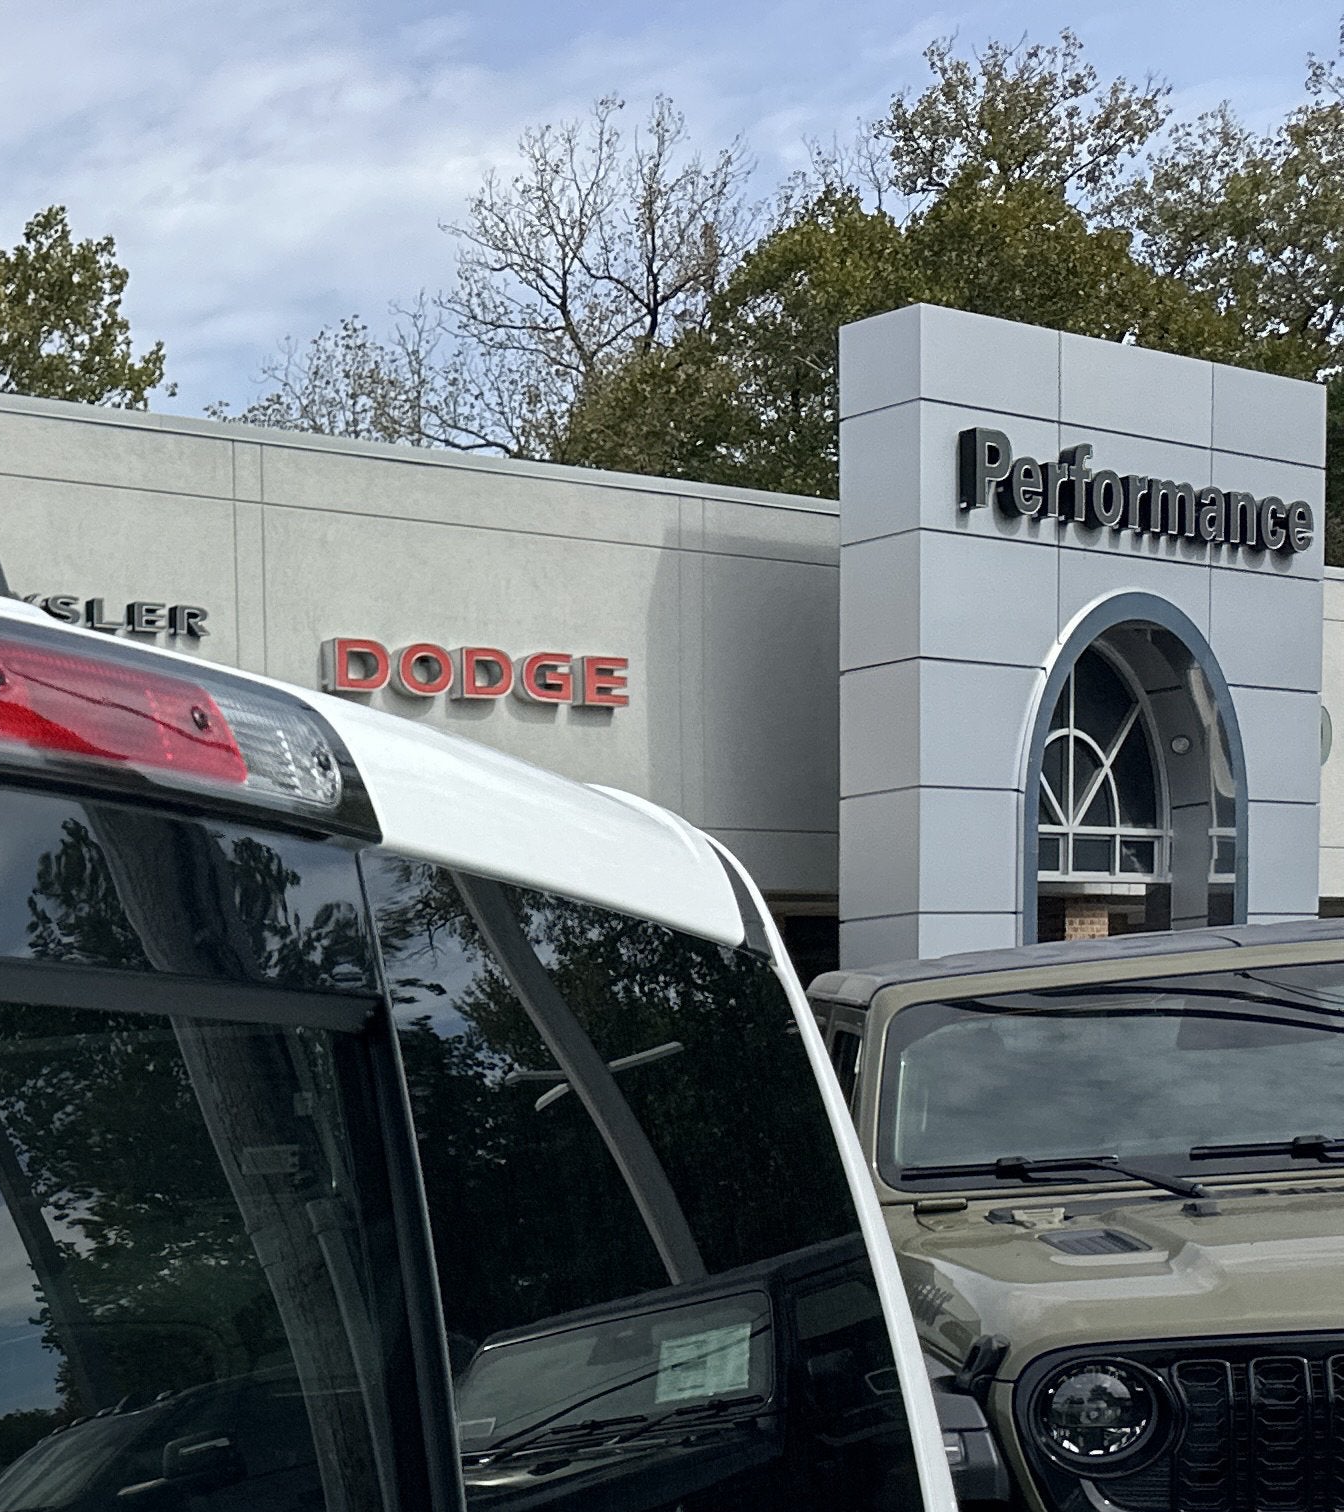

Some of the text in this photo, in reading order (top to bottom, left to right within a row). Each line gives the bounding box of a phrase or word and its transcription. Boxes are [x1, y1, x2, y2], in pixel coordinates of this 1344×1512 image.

[958, 427, 1313, 553] Performance
[23, 593, 210, 637] SLER
[321, 637, 630, 707] DODGE
